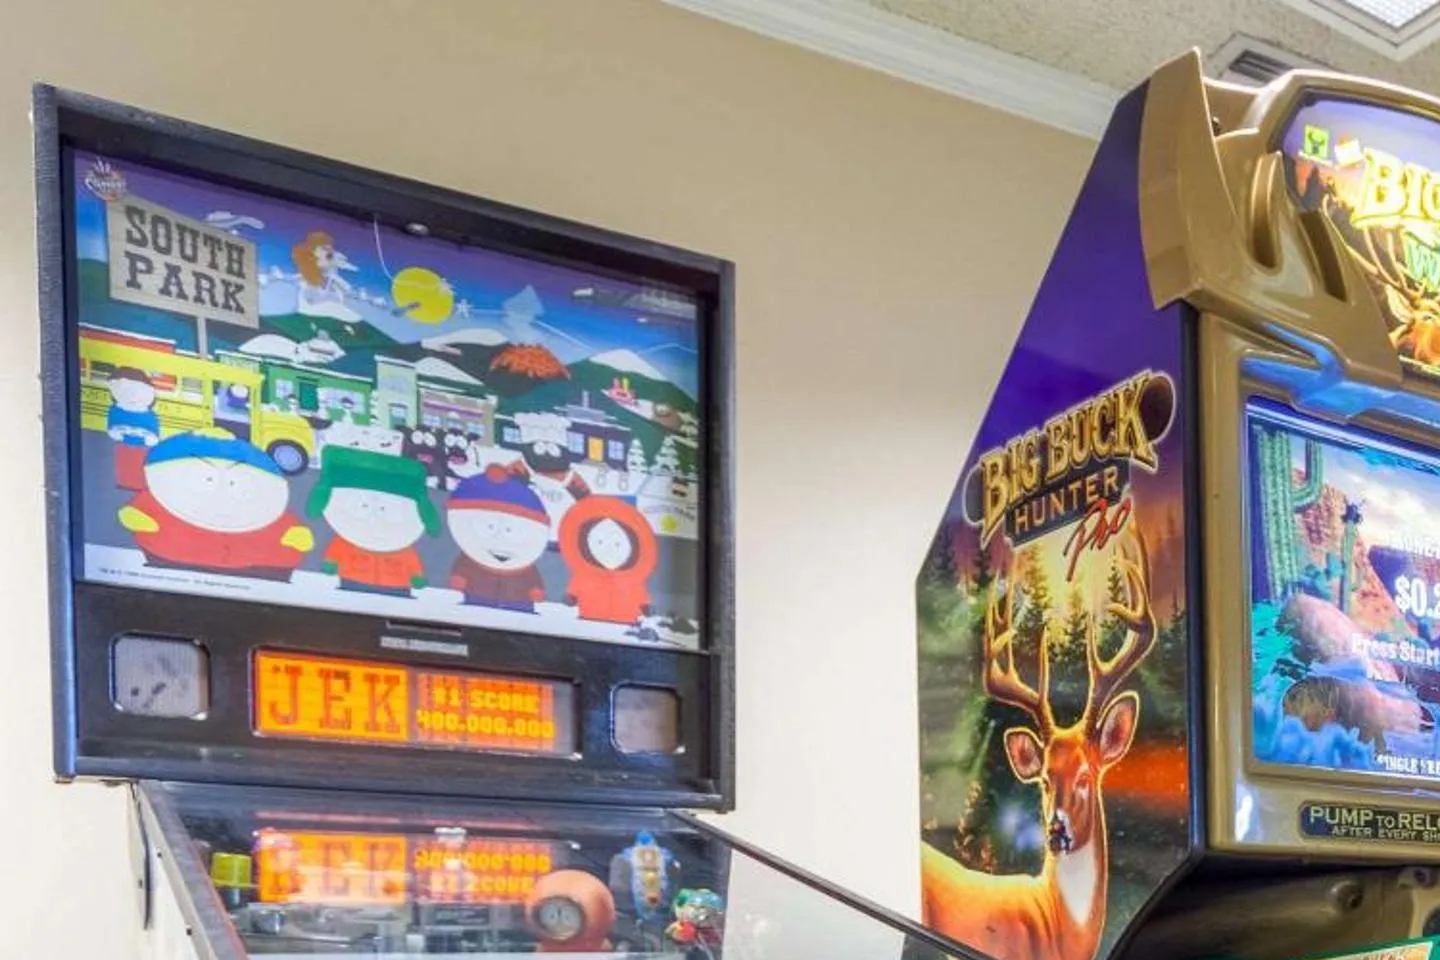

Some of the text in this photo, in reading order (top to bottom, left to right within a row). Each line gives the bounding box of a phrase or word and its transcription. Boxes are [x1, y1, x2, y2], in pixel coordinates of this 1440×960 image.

[125, 205, 246, 279] SOUTH
[125, 251, 245, 314] PARK
[982, 373, 1157, 543] BIG BUCK
[1014, 465, 1120, 534] HUNTER
[1352, 634, 1397, 659] Press
[1400, 641, 1439, 666] Start
[267, 663, 401, 733] JEK
[469, 688, 539, 715] SCORE
[1309, 806, 1375, 827] PUMP
[1376, 814, 1396, 829] TO
[1331, 825, 1376, 838] AFTER
[1378, 828, 1417, 841] EVERY
